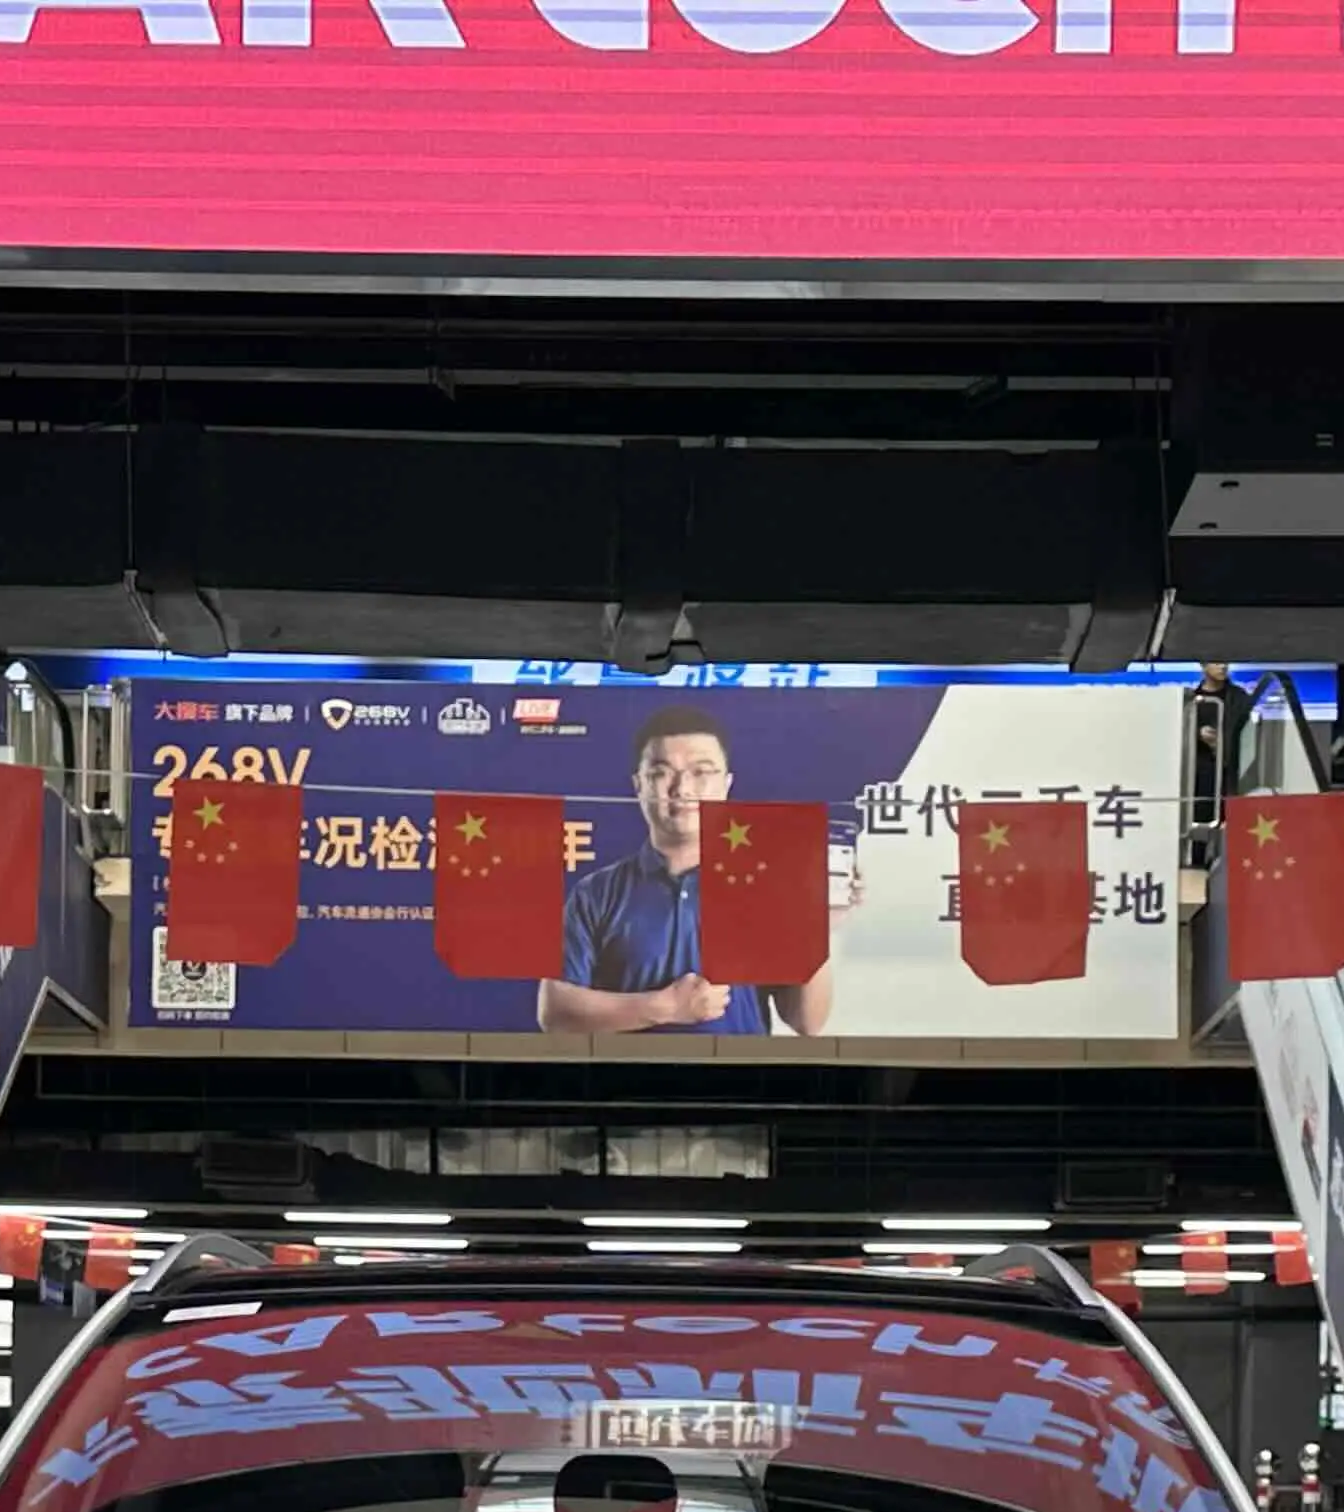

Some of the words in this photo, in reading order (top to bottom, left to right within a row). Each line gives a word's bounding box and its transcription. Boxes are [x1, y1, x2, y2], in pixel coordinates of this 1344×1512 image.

[153, 745, 311, 796] 268V
[858, 783, 1143, 838] 世代车
